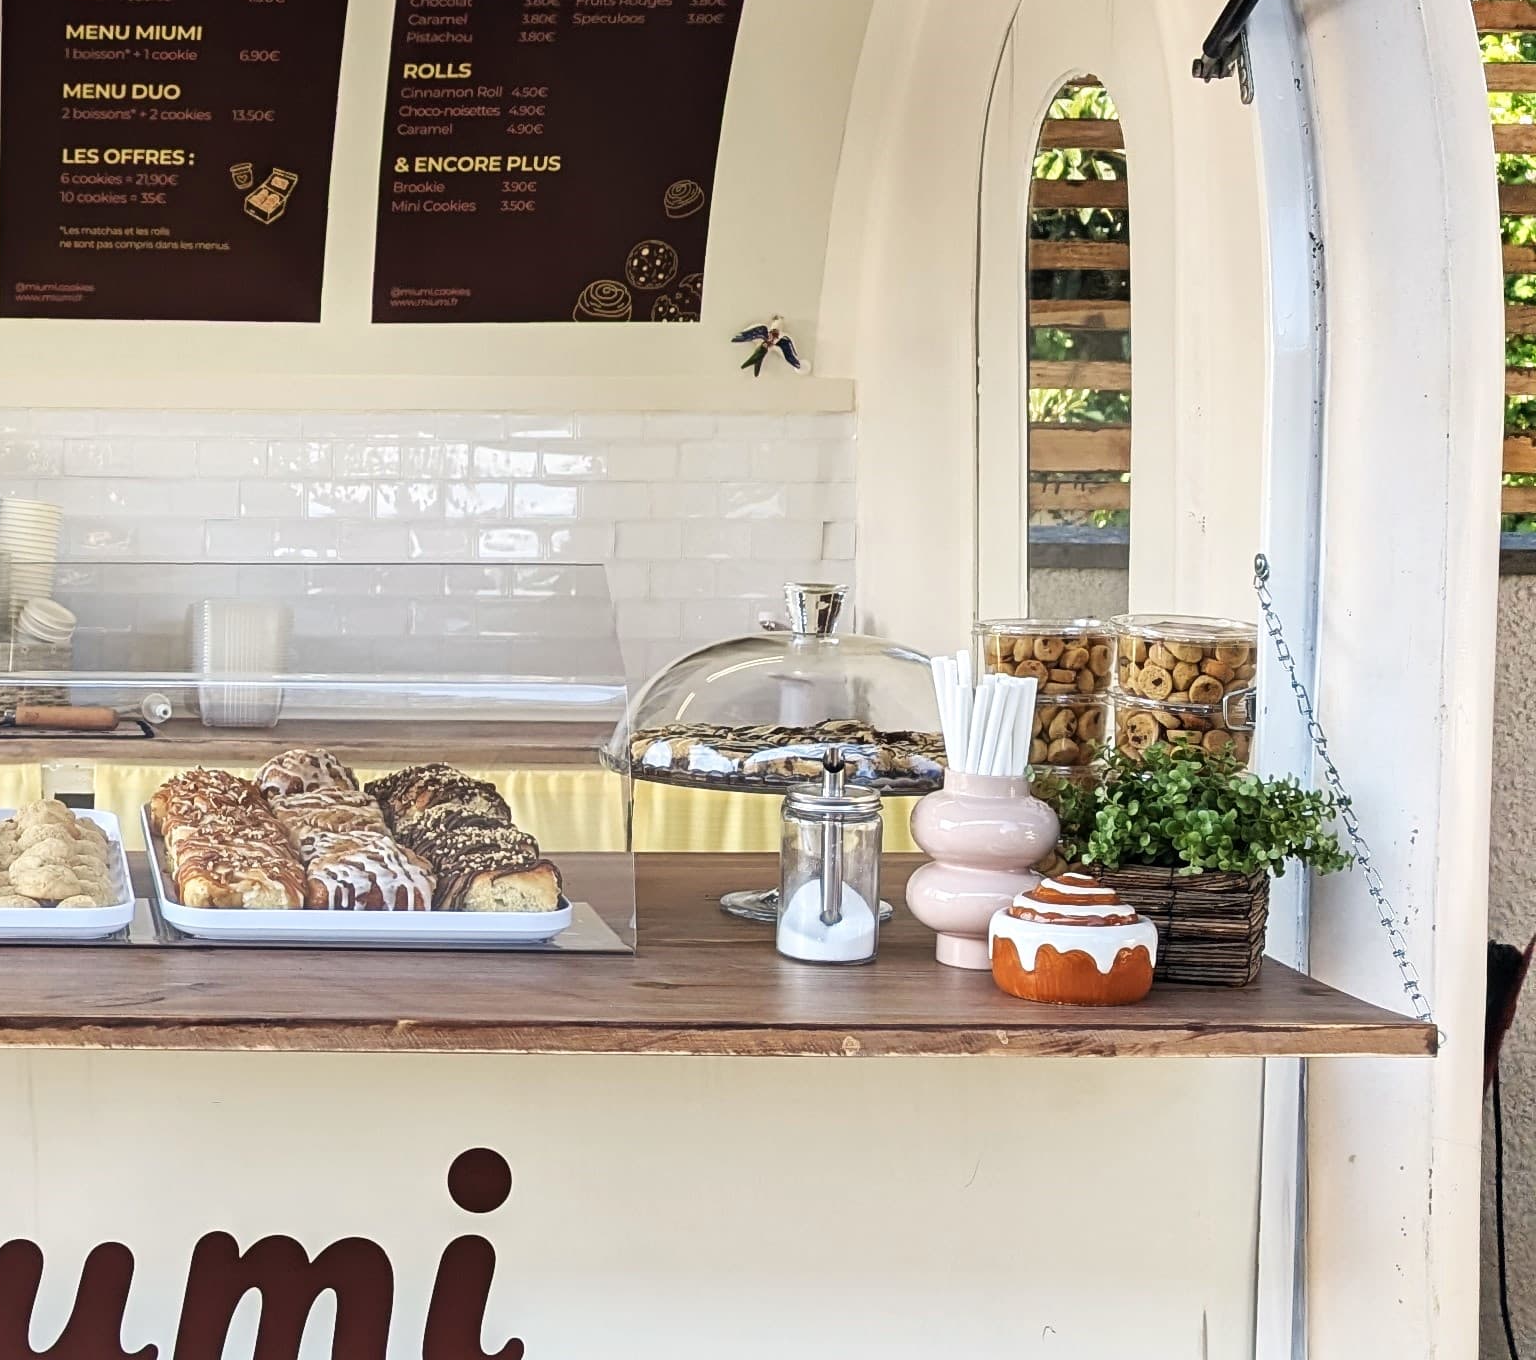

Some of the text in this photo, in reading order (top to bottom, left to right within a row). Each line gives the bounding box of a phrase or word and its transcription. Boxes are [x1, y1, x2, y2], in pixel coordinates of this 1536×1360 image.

[408, 14, 468, 25] Caramel
[66, 25, 202, 40] MENU MIUMI
[152, 50, 197, 60] cookie
[404, 63, 471, 78] ROLLS
[63, 84, 180, 99] MENU DUO
[401, 86, 502, 98] Cinnamon Roll
[62, 108, 70, 119] 2
[150, 109, 158, 120] 2
[161, 109, 211, 120] cookies
[399, 105, 500, 117] Choco-noisettes
[397, 124, 452, 135] Caramel
[63, 149, 184, 165] LES OFFRES
[395, 156, 560, 172] & ENCORE PLUS
[61, 173, 70, 184] 6
[72, 174, 123, 184] cookies
[393, 182, 445, 192] Brookie
[60, 192, 166, 203] 10 cookies 35€
[392, 200, 476, 212] Mini Cookies
